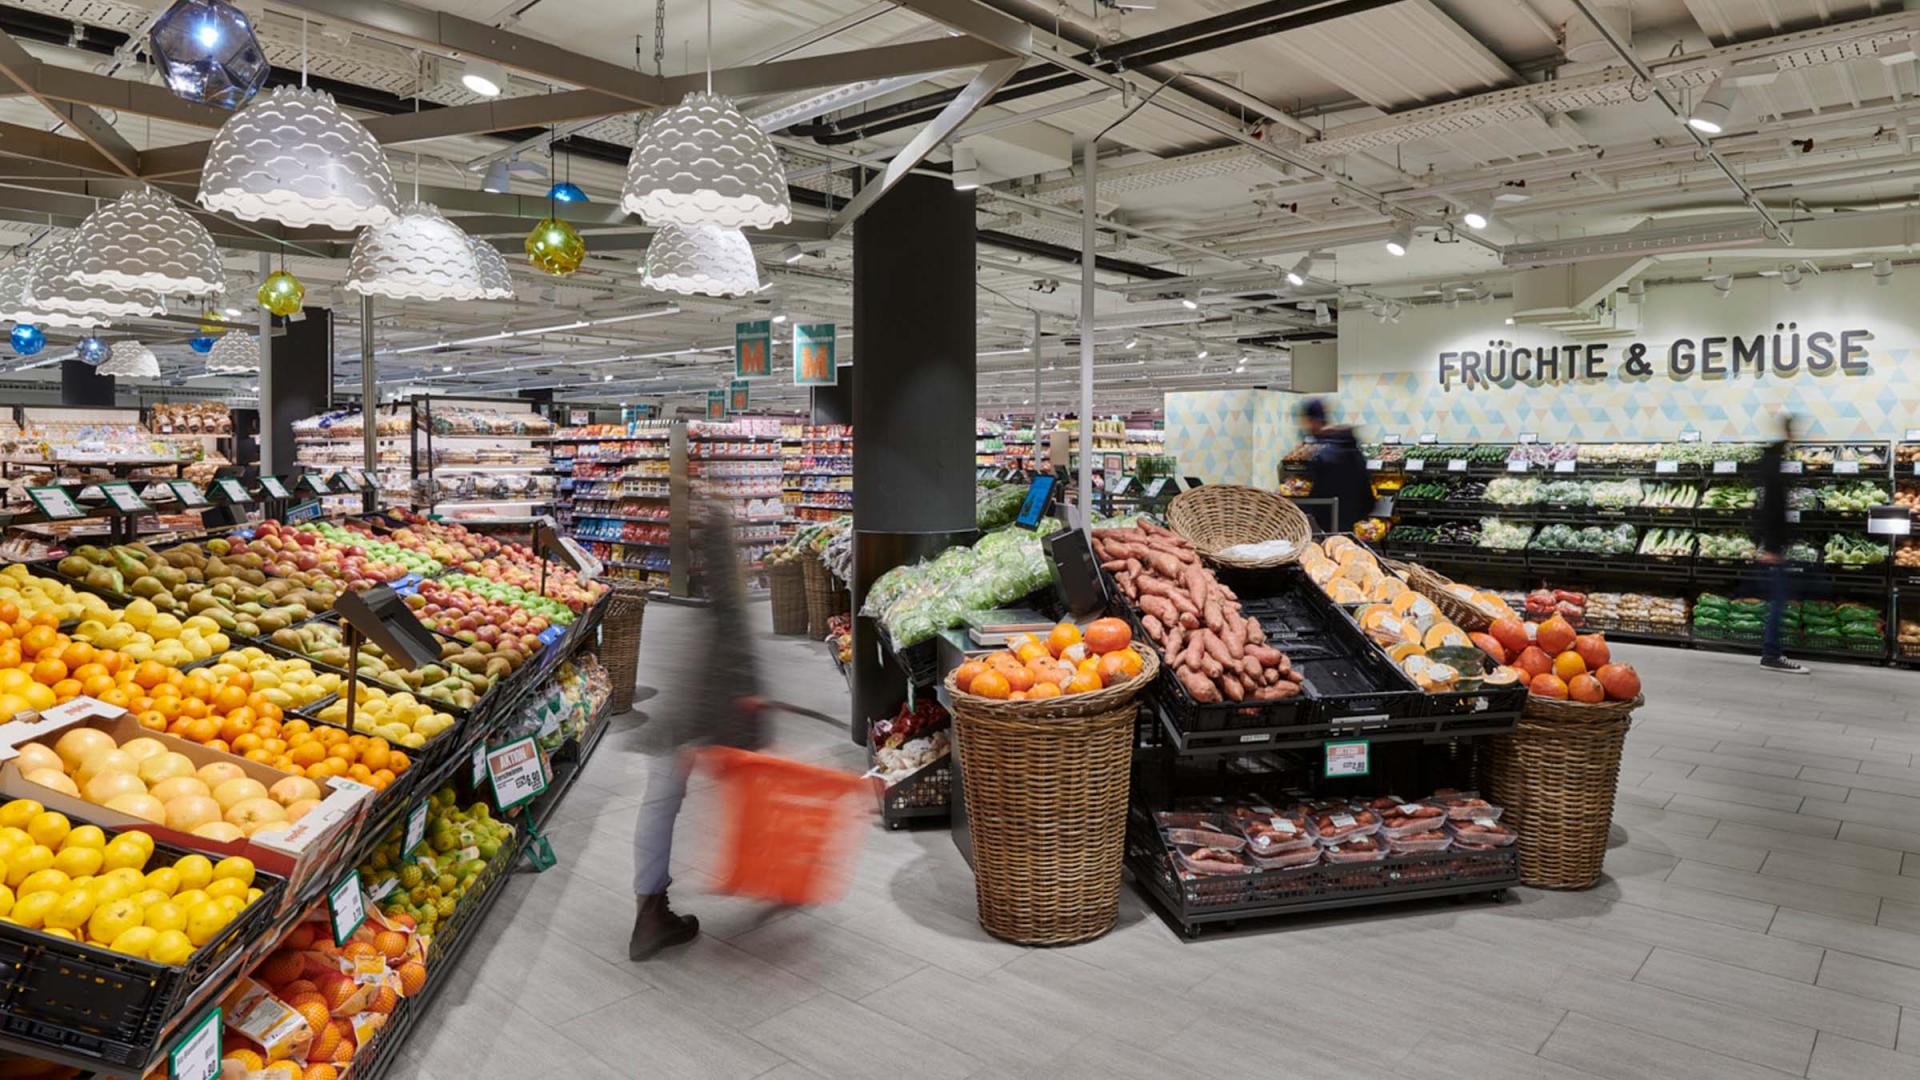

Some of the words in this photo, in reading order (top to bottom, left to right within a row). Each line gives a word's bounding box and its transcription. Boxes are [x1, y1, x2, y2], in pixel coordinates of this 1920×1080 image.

[742, 340, 765, 373] M
[803, 345, 828, 379] M
[1439, 339, 1609, 385] FRÜCHTE
[1625, 343, 1654, 376] &
[1670, 322, 1870, 375] GEMÜSE
